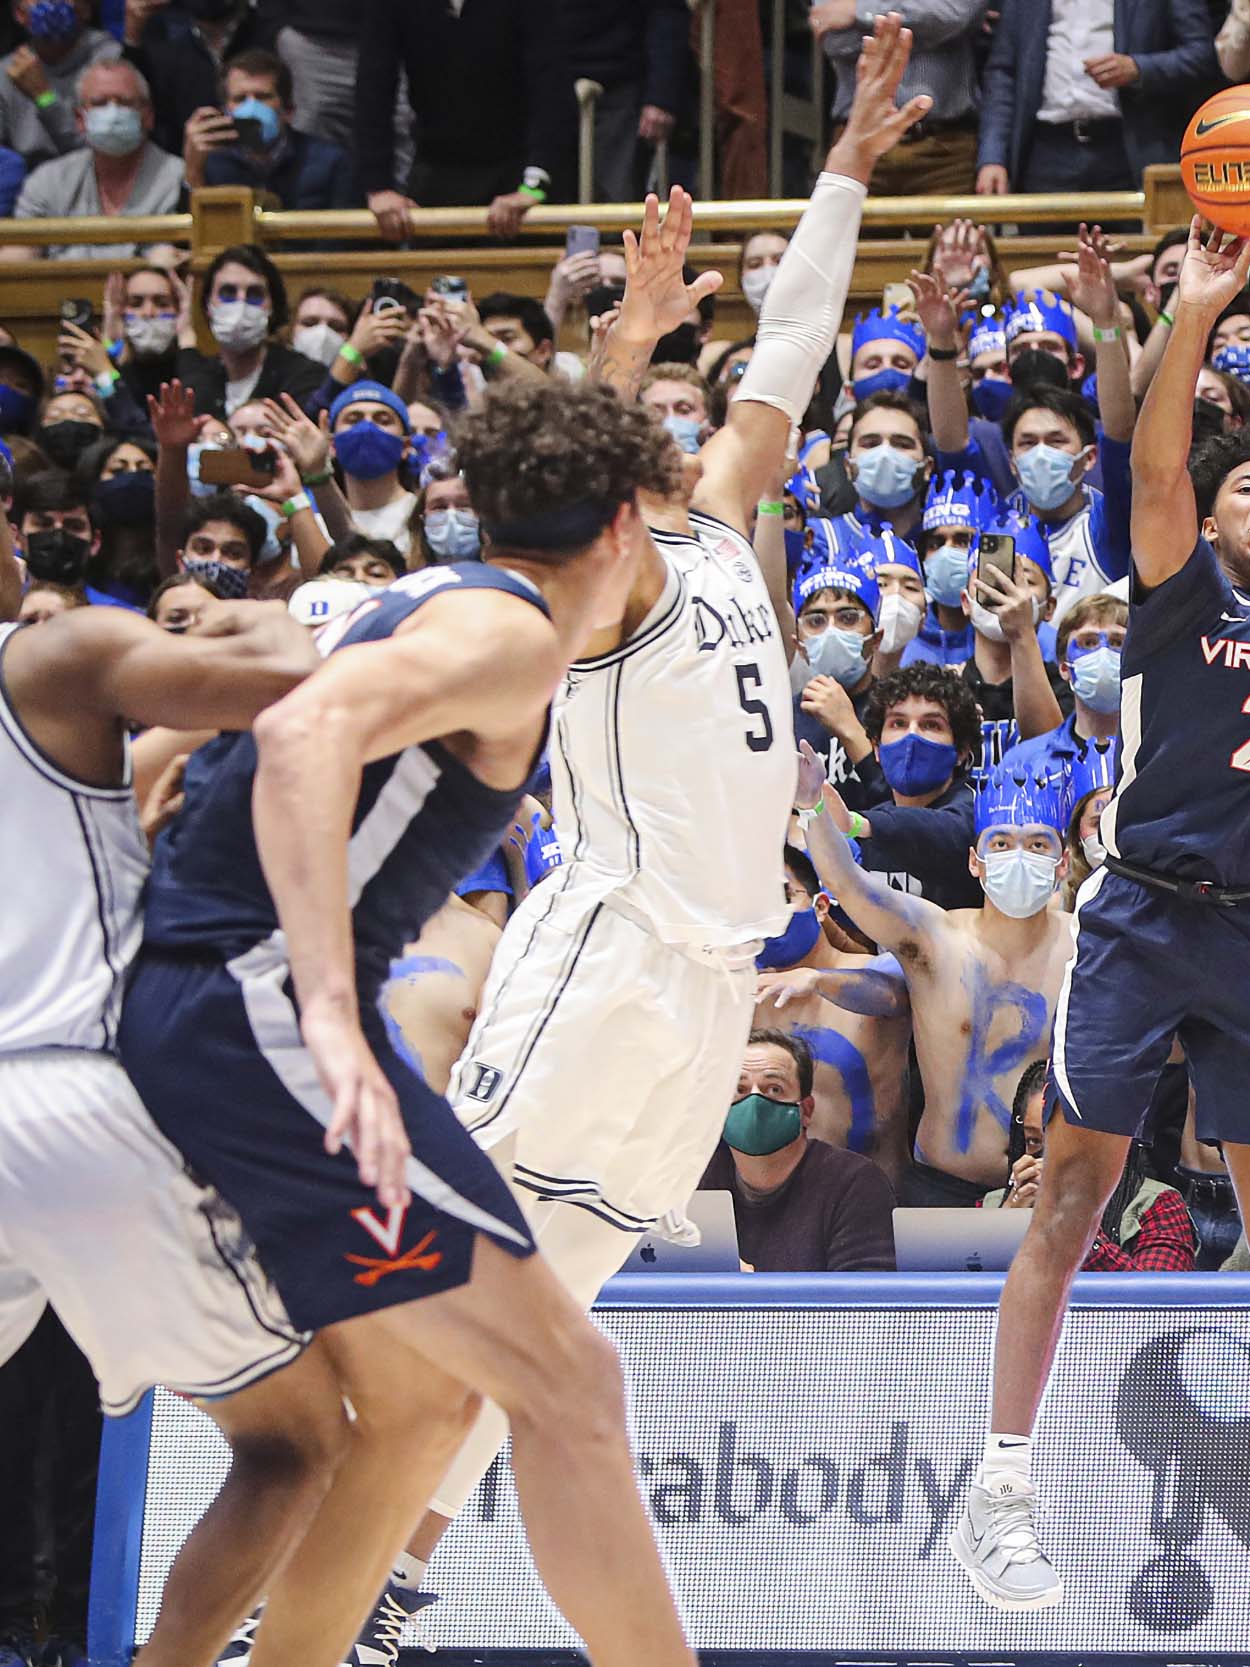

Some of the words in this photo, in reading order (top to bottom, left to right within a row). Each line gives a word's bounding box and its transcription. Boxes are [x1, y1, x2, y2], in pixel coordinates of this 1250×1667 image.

[691, 595, 773, 652] Duke
[734, 662, 774, 753] 5
[957, 966, 1047, 1154] R
